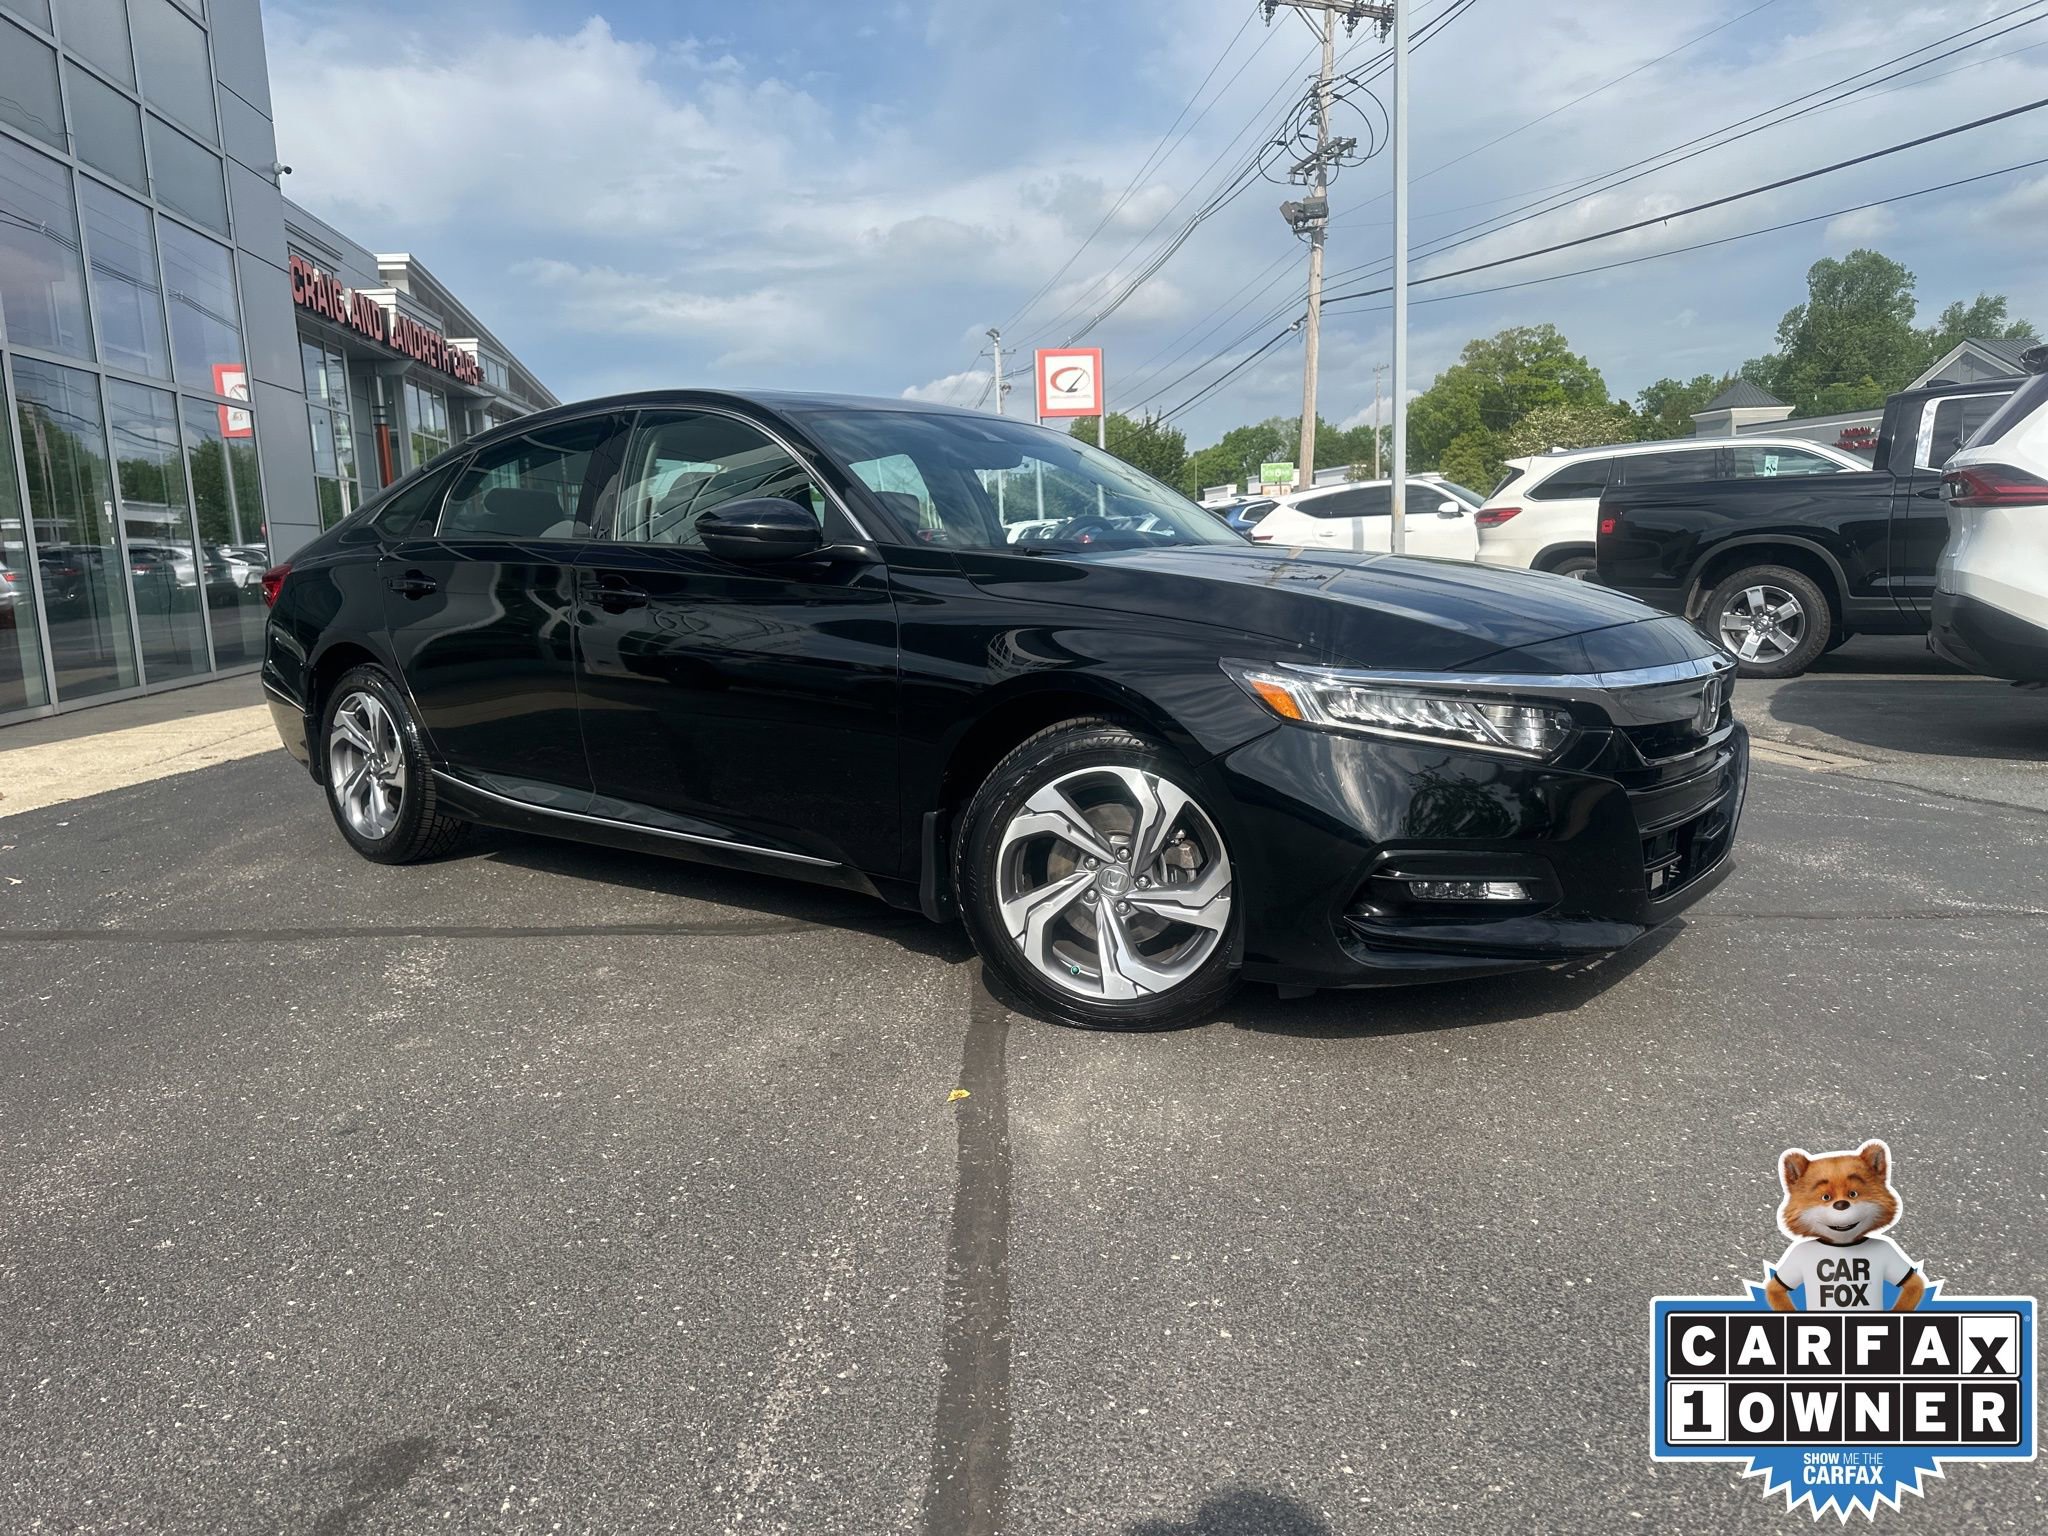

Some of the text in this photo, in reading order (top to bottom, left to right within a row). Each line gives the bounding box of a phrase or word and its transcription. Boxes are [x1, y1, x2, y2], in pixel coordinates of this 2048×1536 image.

[288, 254, 479, 386] CRAIG AND LANDRETH CARS
